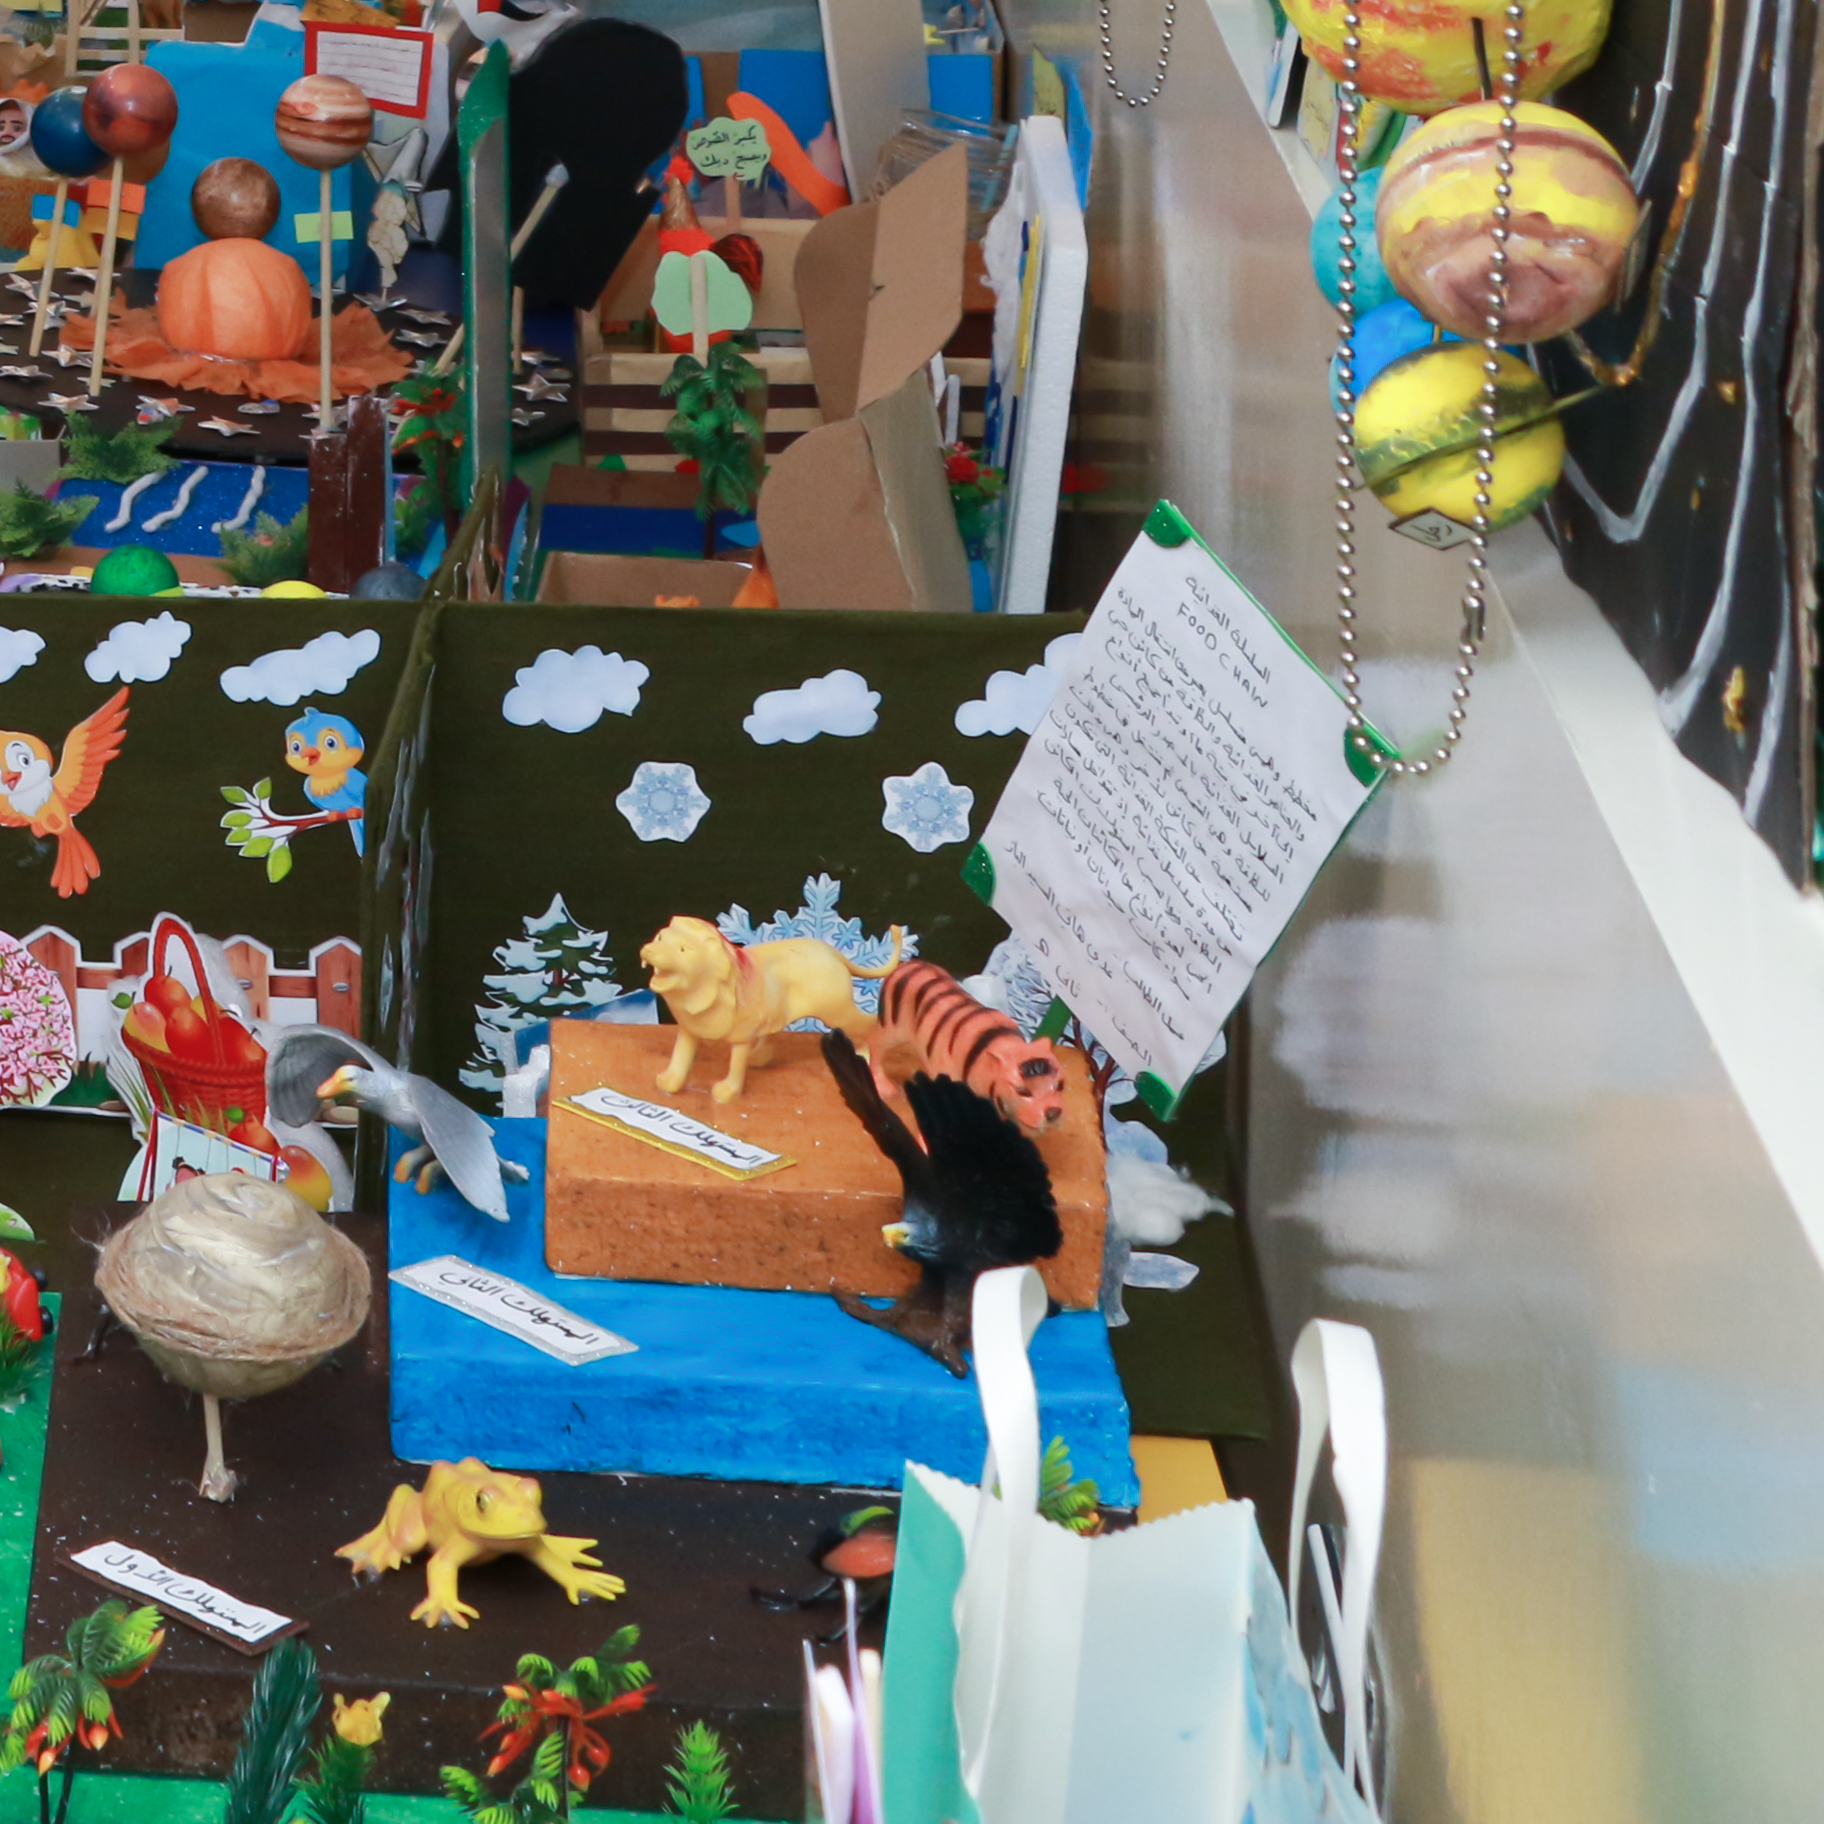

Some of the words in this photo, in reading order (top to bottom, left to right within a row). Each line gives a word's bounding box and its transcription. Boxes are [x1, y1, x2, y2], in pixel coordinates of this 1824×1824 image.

[1174, 600, 1218, 652] FOOD
[1217, 650, 1269, 709] CHAIN
[601, 1094, 672, 1123] الثالث
[669, 1121, 763, 1165] المستهلك
[500, 1293, 600, 1345] المستهلك
[164, 1582, 267, 1634] المستهلك
